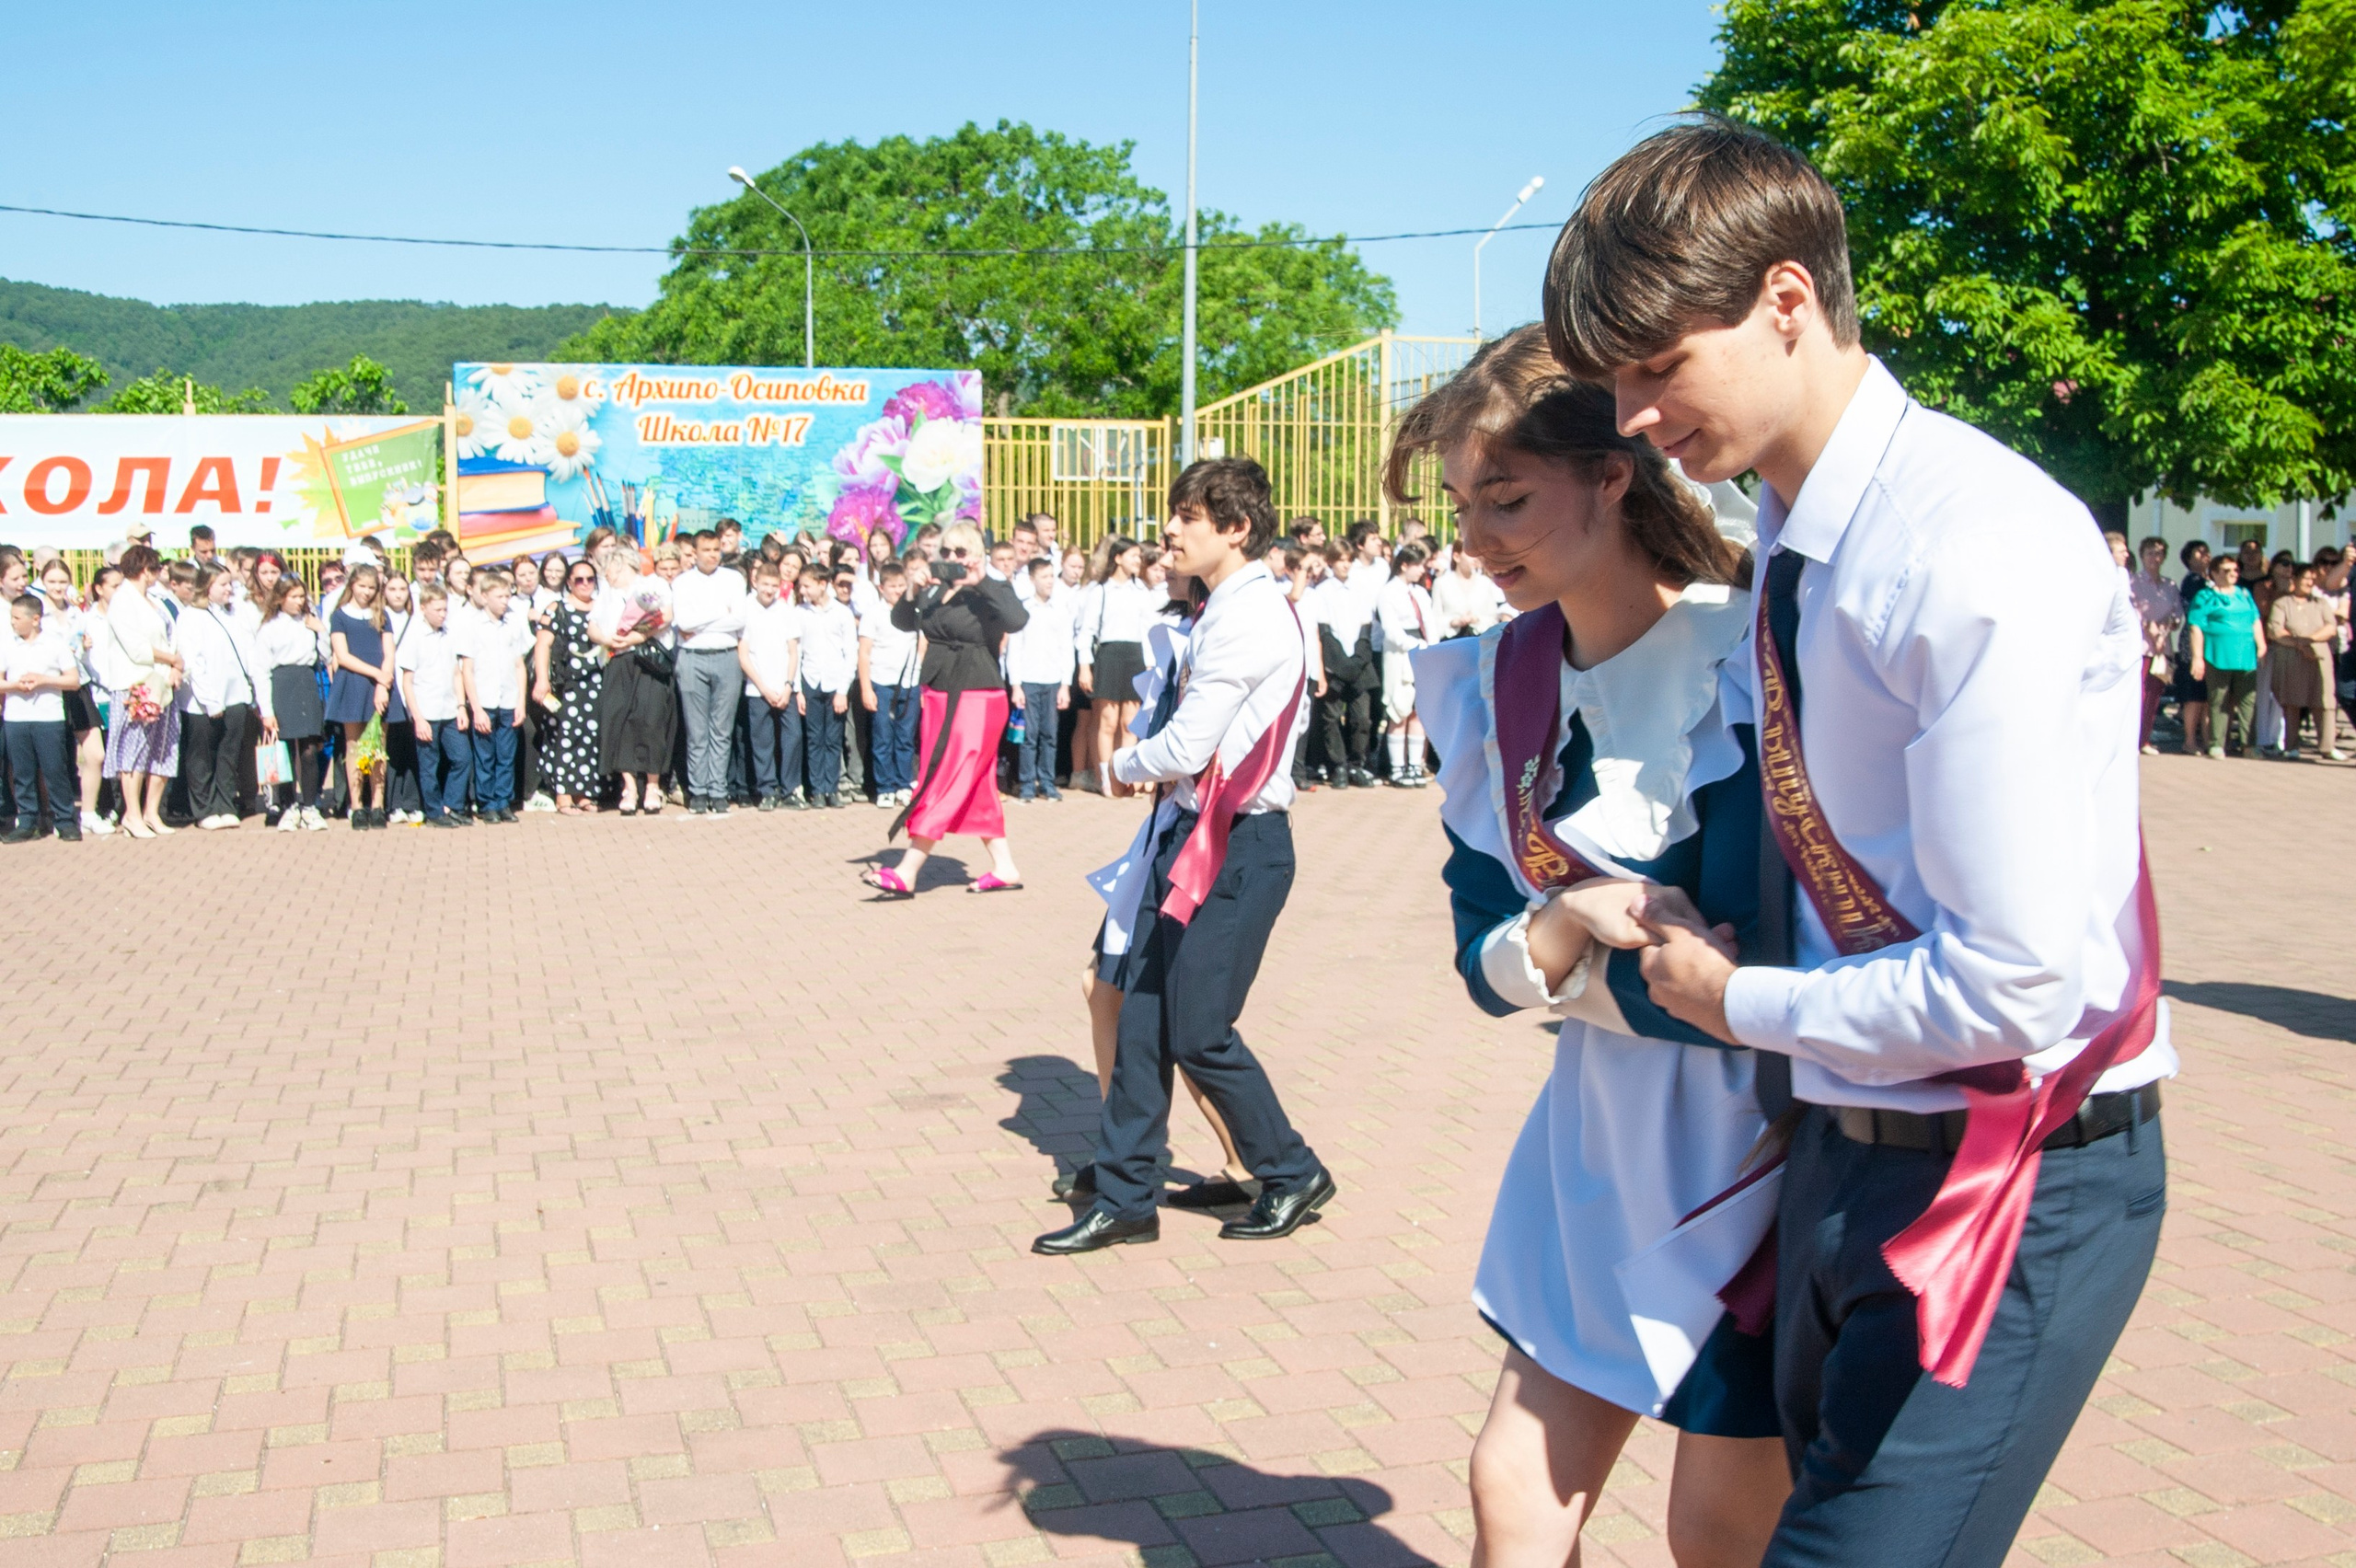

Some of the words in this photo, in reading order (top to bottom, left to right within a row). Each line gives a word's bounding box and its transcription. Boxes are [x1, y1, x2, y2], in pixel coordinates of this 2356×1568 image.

[583, 379, 603, 398] с.
[614, 373, 866, 407] Архипо-Осиповка
[639, 415, 740, 443] Школа
[747, 416, 809, 444] №17
[0, 455, 282, 515] ОЛА!
